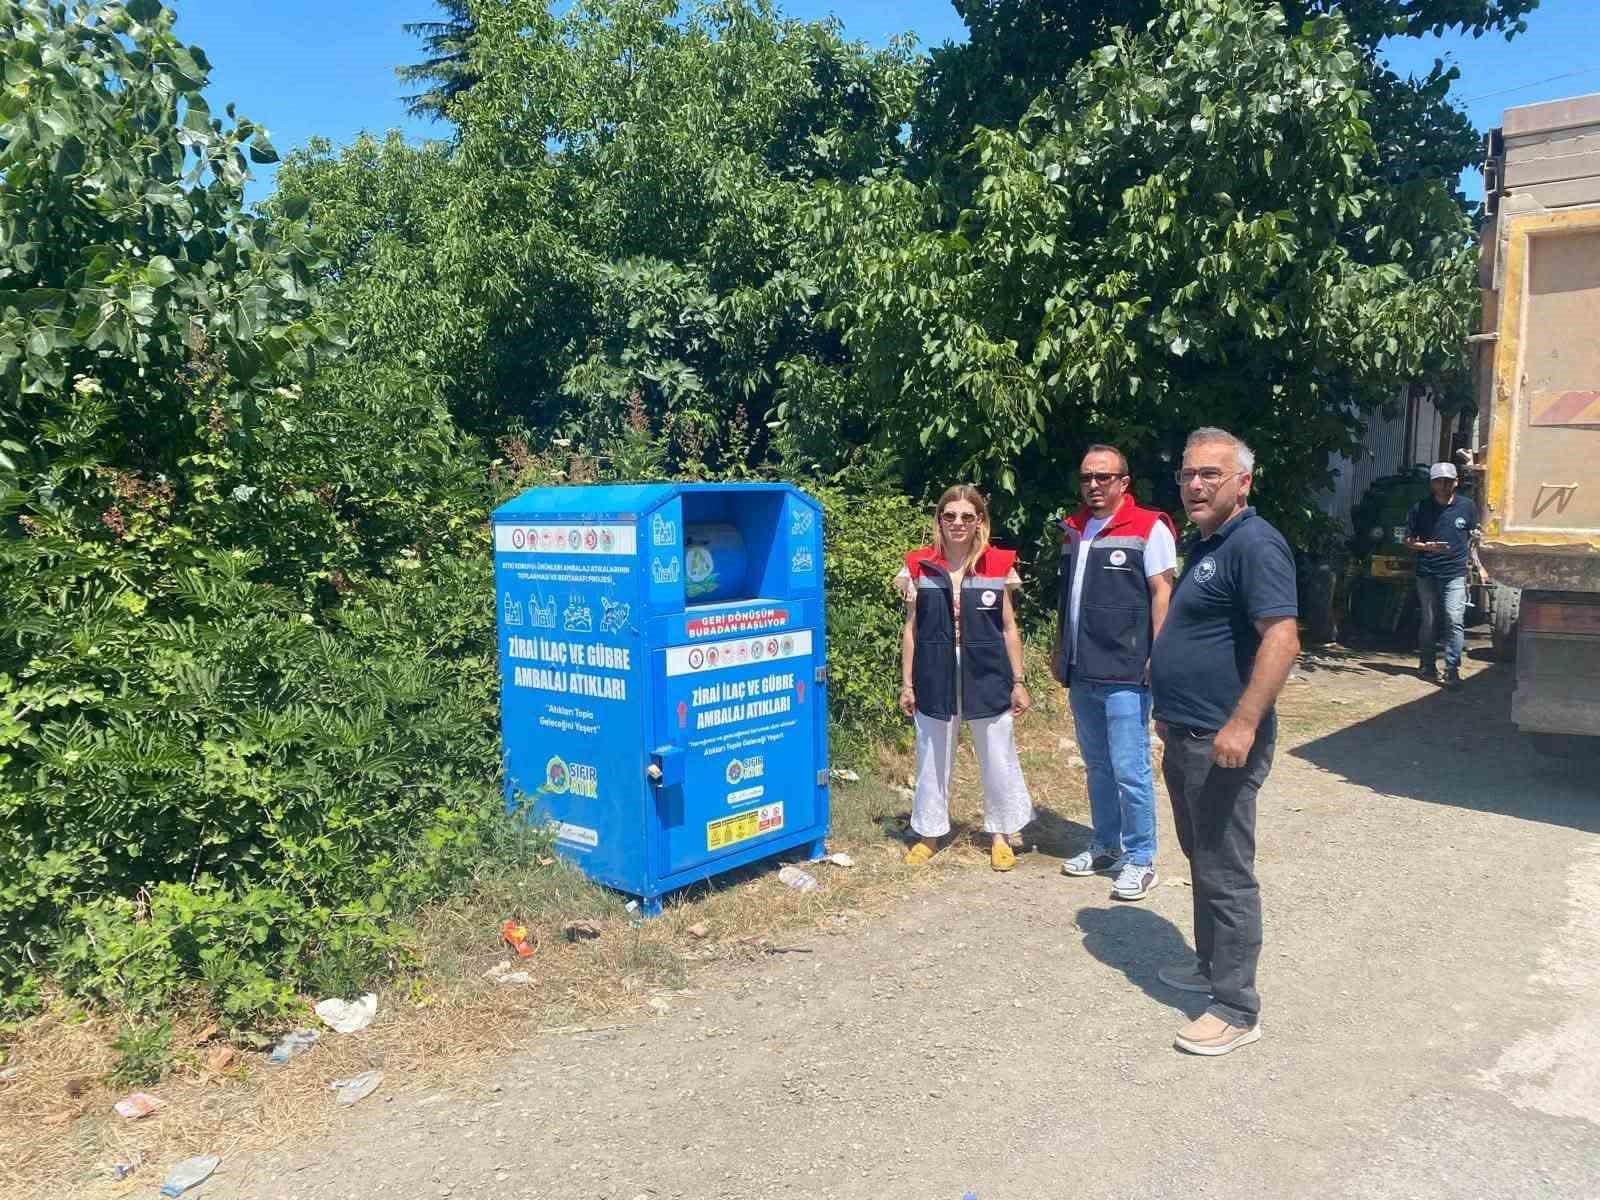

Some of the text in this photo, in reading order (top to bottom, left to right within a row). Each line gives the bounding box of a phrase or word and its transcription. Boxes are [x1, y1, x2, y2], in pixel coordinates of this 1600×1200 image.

[688, 617, 786, 638] BURADAN BAŞLIYOR
[702, 608, 775, 625] GERİ DÖNÜŞÜM
[508, 634, 631, 671] ZİRAİ İLAÇ VE GÜBRE
[514, 666, 626, 700] AMBALAJ ATIKLARI
[692, 673, 795, 707] ZİRAİ İLAÇ VE GÜBRE
[697, 696, 791, 730] AMBALAJ ATIKLARI
[570, 762, 597, 781] SIFIR
